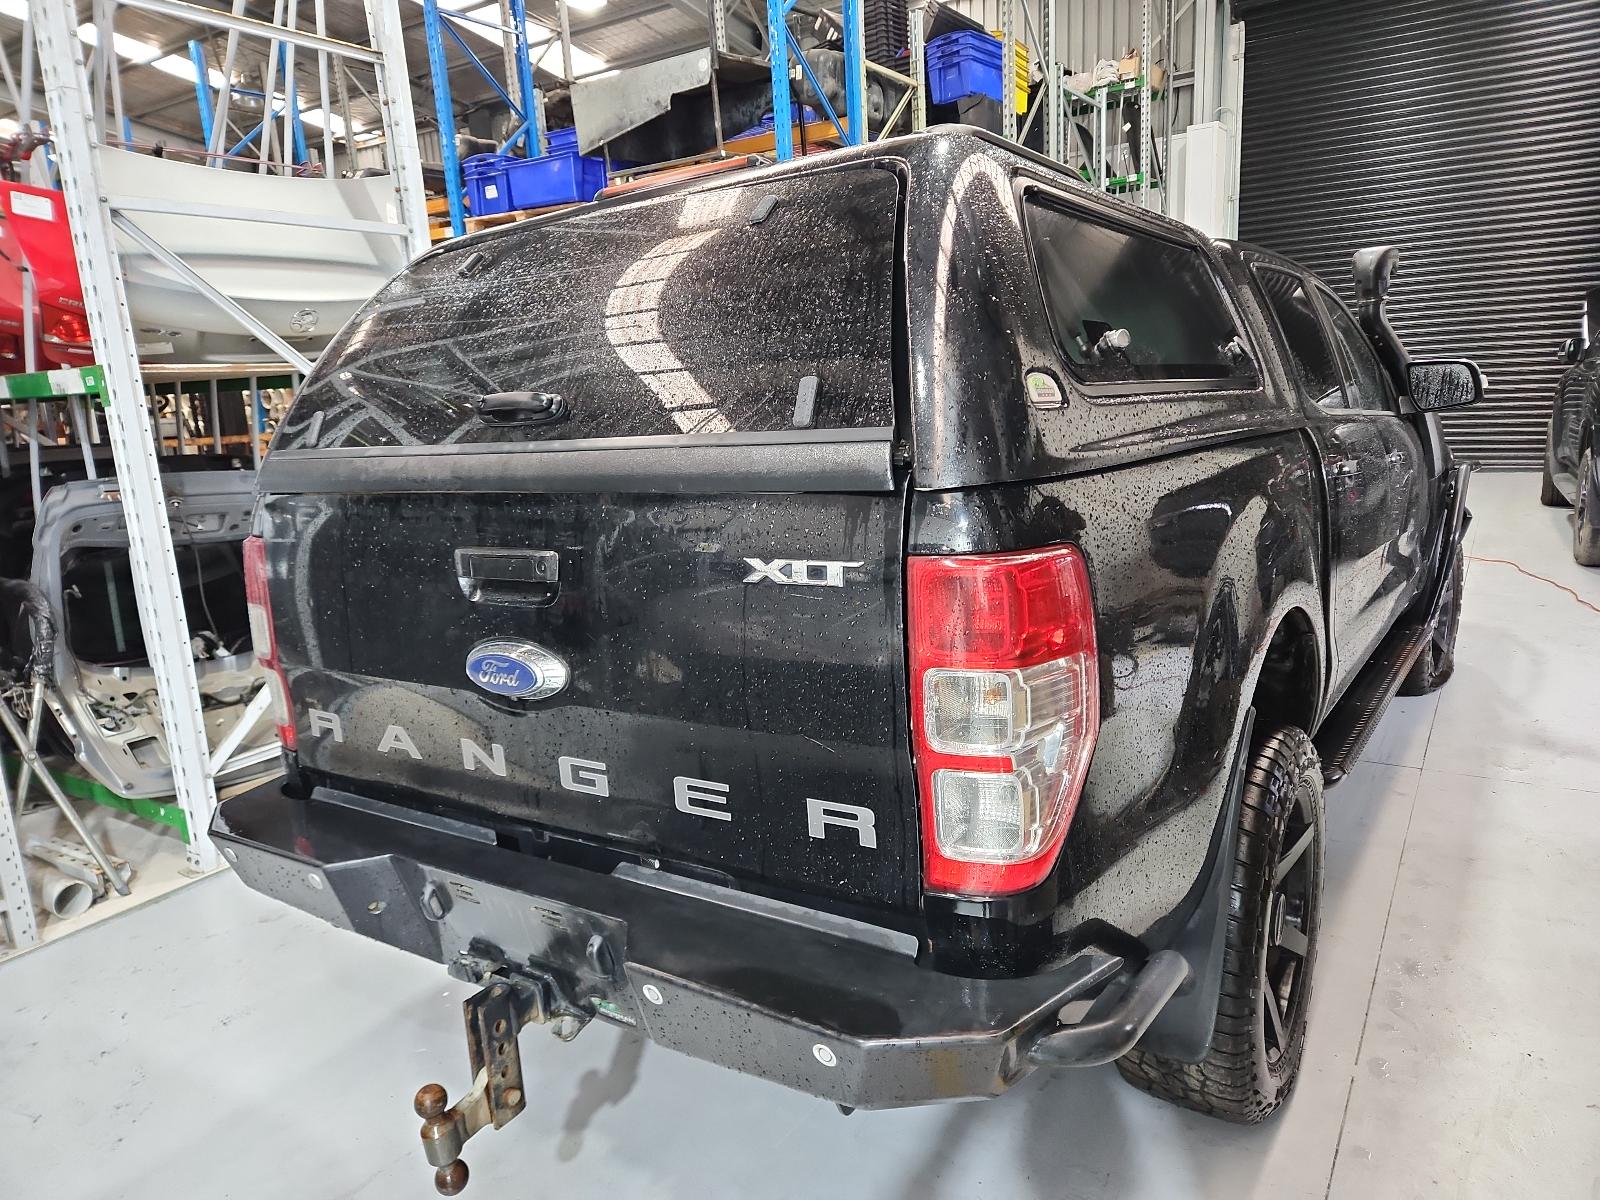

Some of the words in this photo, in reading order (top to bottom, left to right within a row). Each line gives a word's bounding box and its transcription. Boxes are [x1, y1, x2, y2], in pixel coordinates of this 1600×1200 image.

[743, 557, 865, 588] XLT
[479, 659, 520, 687] Ford
[308, 708, 877, 849] RANGER
